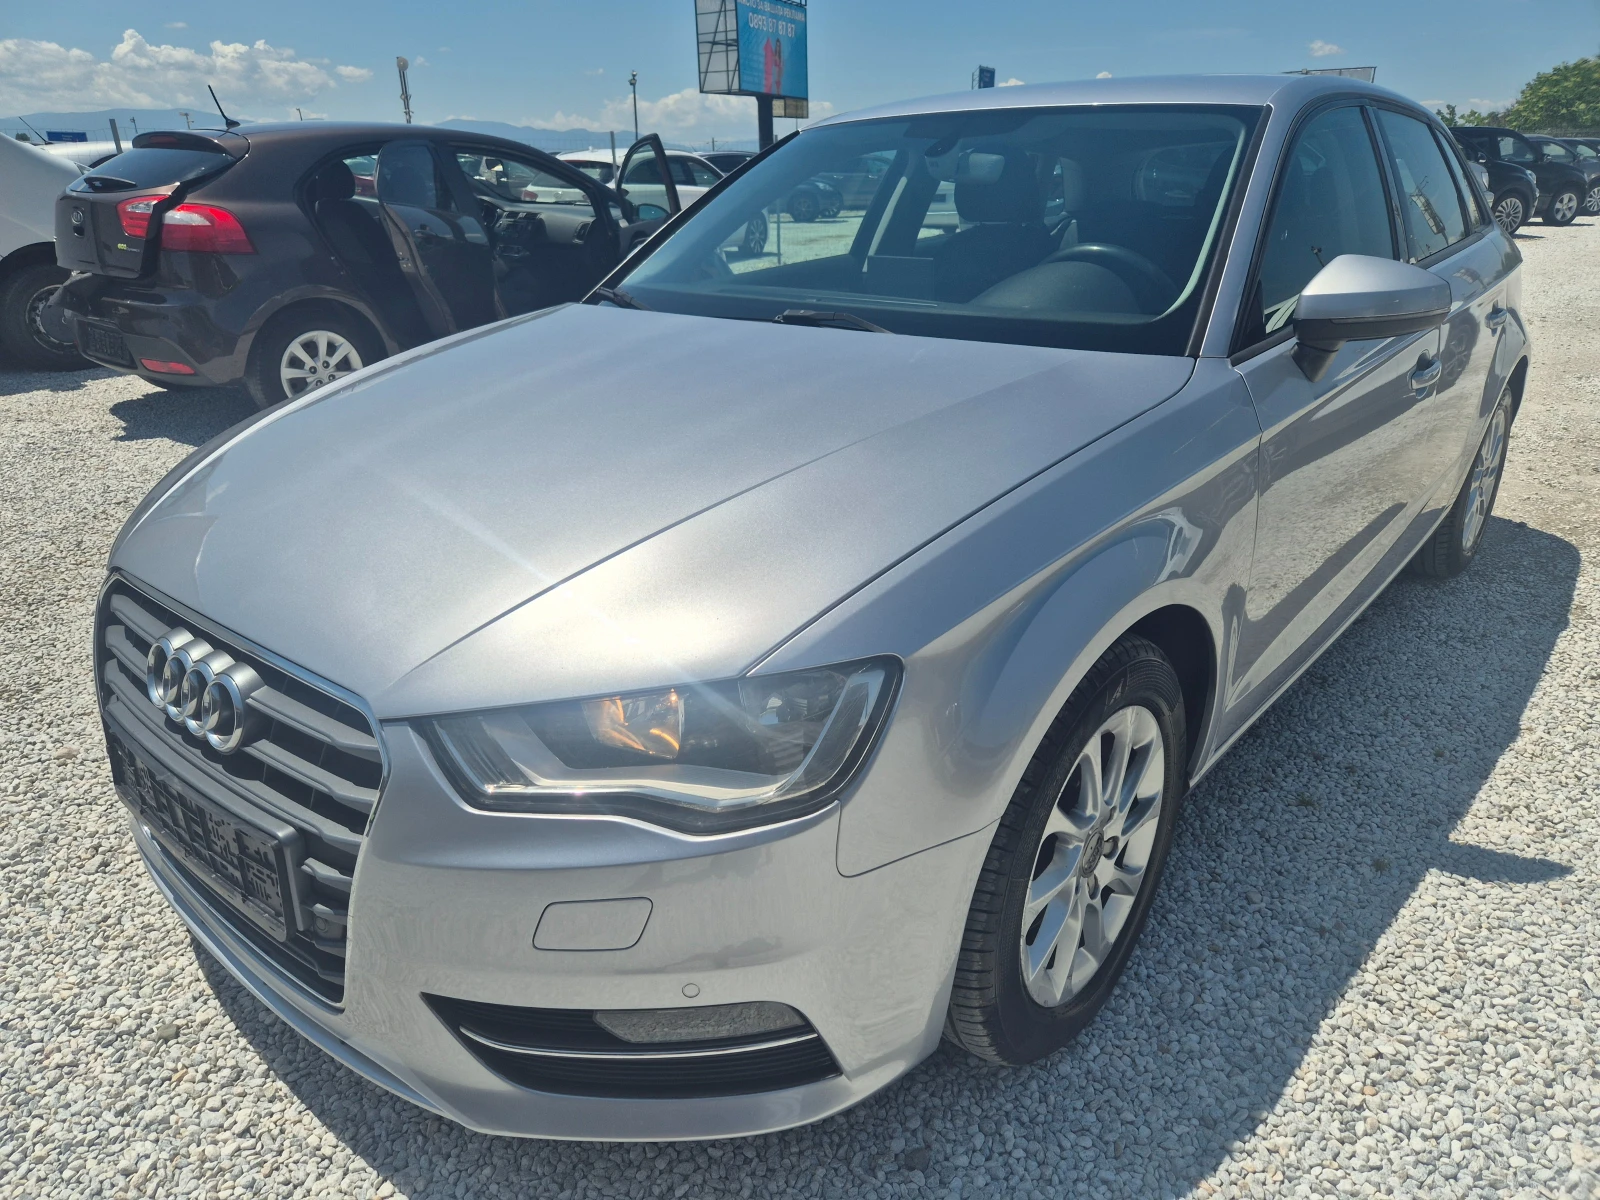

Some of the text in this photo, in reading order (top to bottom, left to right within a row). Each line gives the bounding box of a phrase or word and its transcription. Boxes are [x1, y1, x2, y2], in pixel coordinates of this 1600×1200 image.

[748, 12, 795, 38] 0893 87 87 87
